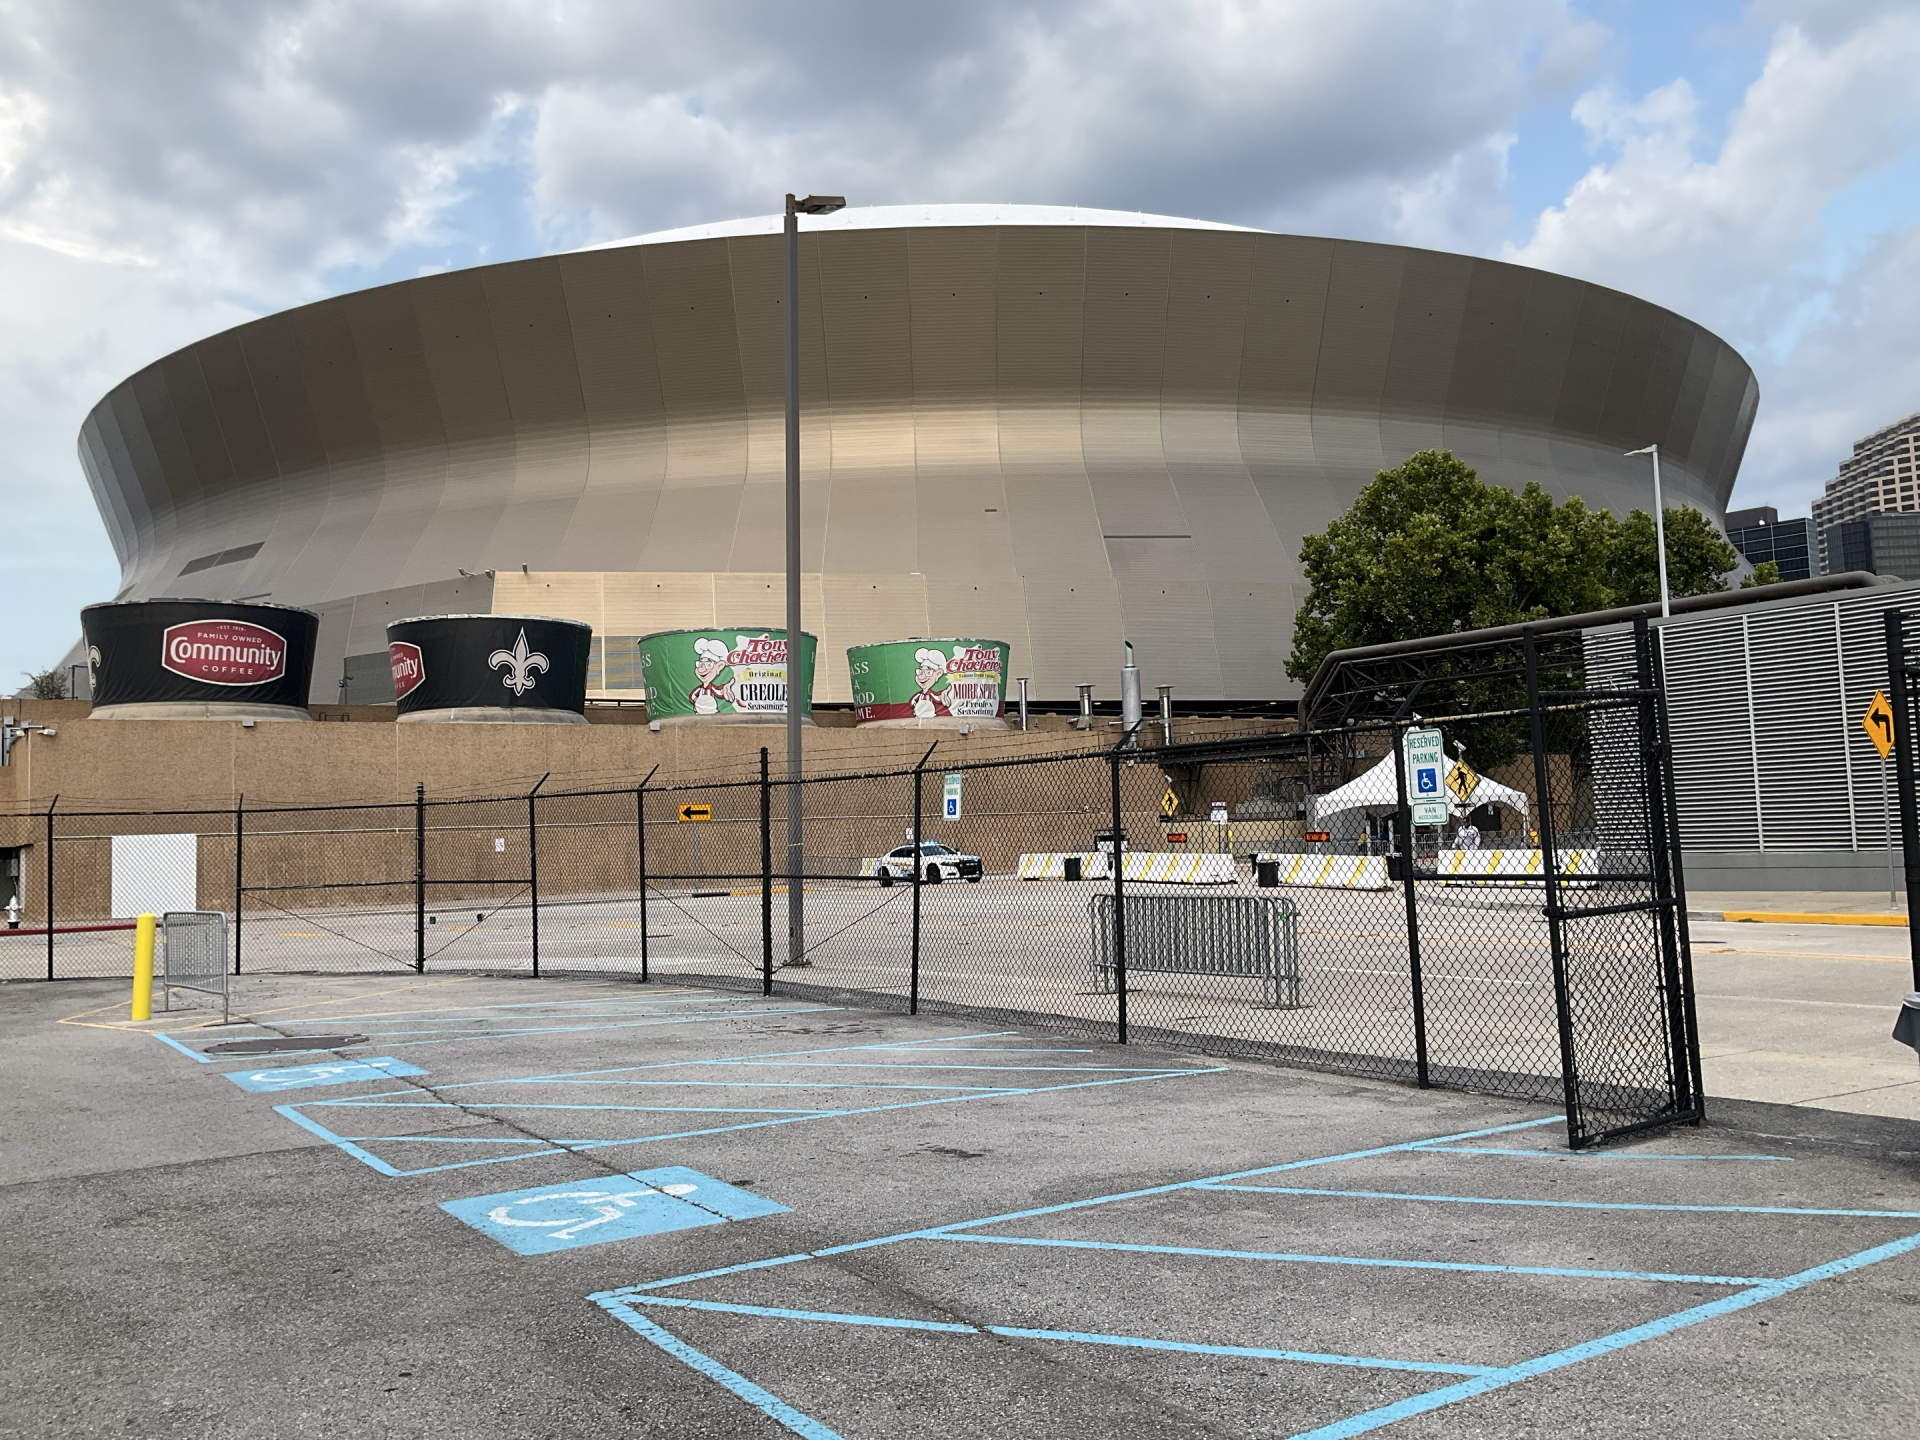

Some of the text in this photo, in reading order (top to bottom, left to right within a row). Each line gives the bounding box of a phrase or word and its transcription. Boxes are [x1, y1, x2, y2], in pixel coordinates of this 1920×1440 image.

[197, 632, 262, 643] FAMILY OWNED
[170, 636, 281, 670] Community
[642, 654, 651, 668] SS
[202, 665, 253, 675] COFFEE
[851, 661, 869, 675] ASS
[953, 683, 979, 699] MORE
[854, 691, 875, 705] OOD
[747, 702, 785, 711] Seasoning
[1409, 736, 1440, 749] RESERVED
[1412, 752, 1438, 764] PARKING
